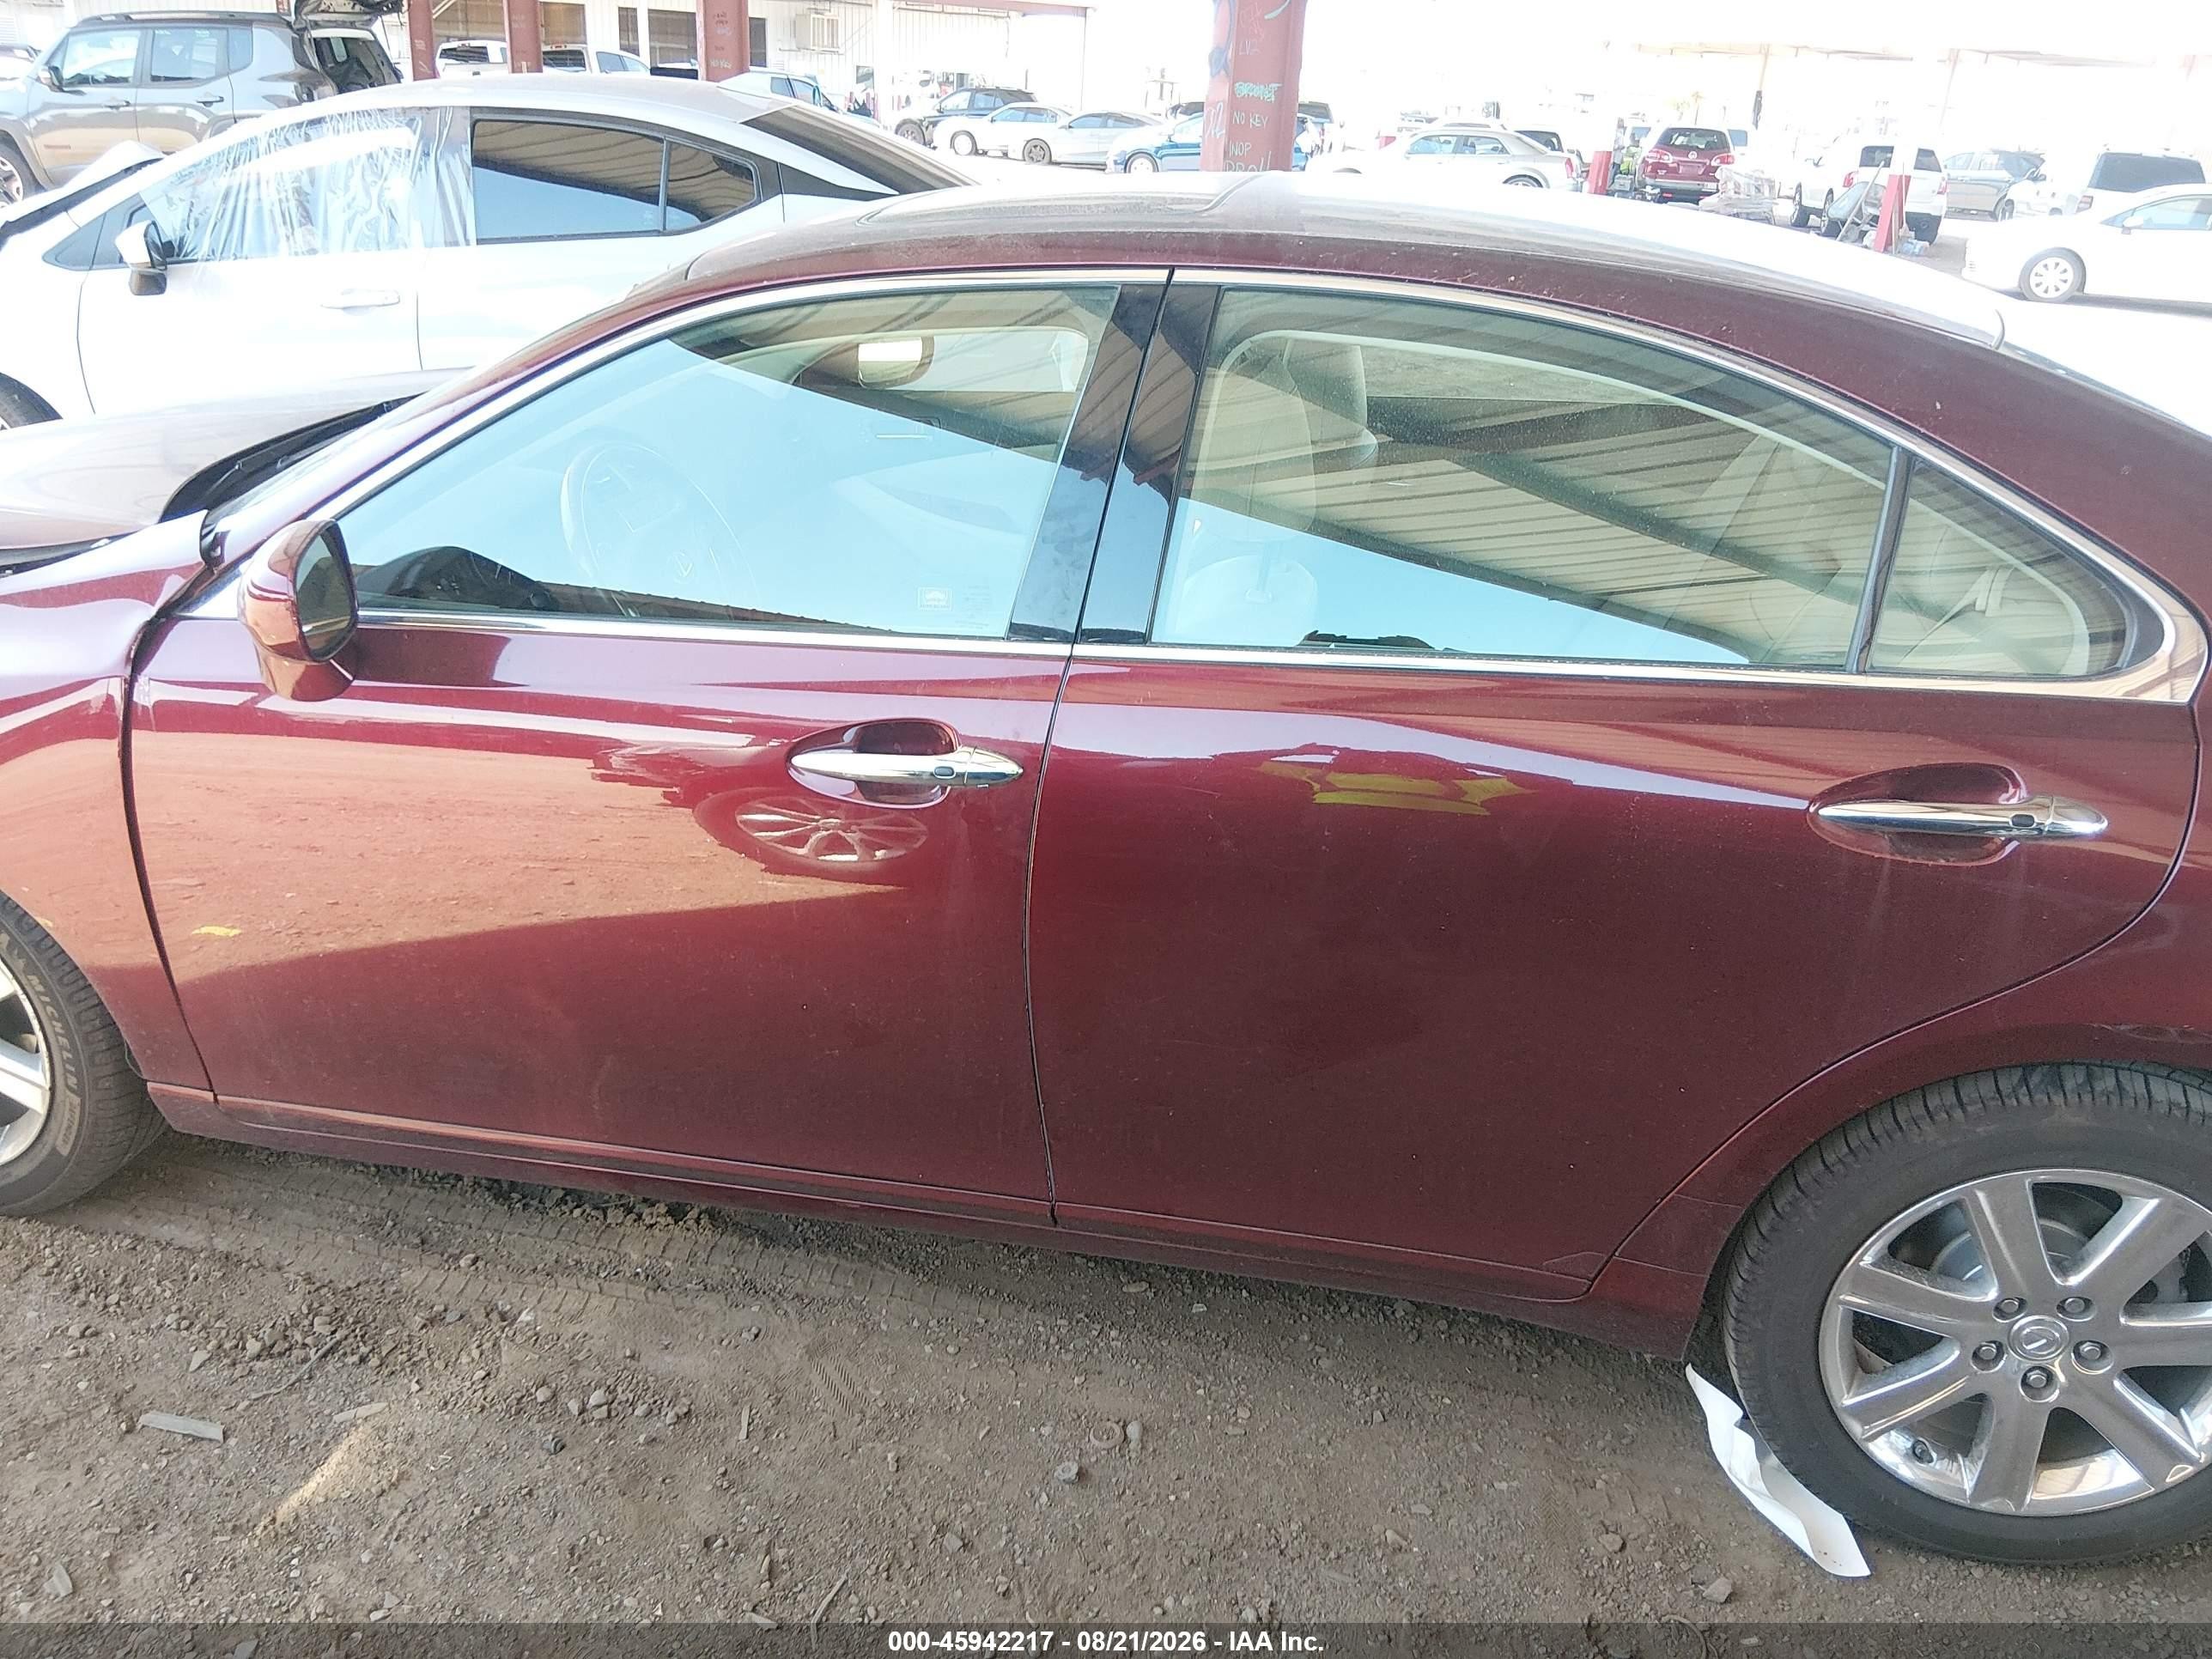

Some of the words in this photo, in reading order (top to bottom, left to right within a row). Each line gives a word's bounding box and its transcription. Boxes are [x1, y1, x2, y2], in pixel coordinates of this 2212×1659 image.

[1233, 110, 1245, 125] NO
[1250, 112, 1268, 130] KEY
[1230, 140, 1251, 158] INOP
[27, 975, 78, 1091] MICHELIN
